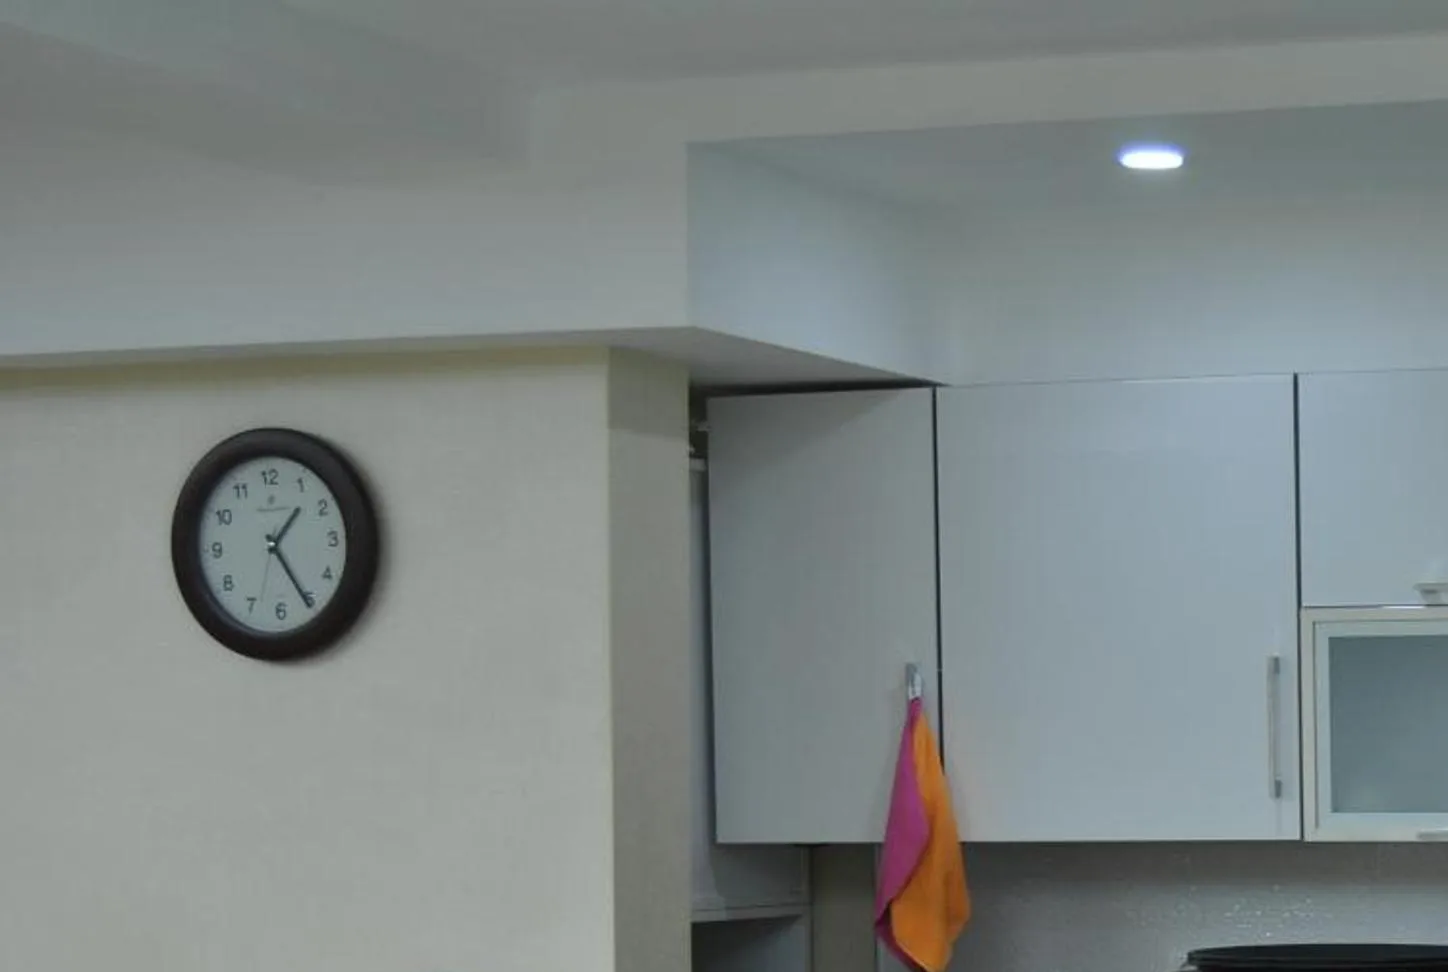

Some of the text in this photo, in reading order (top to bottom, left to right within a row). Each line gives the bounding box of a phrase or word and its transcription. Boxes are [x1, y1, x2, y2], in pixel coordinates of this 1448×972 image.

[261, 468, 279, 487] 12
[296, 477, 305, 494] 1
[232, 483, 249, 500] 11
[318, 498, 329, 517] 2
[216, 508, 233, 526] 10
[326, 530, 339, 548] 3
[211, 541, 223, 559] 9
[321, 565, 333, 580] 4
[222, 574, 234, 592] 8
[246, 597, 258, 614] 7
[275, 602, 287, 621] 6
